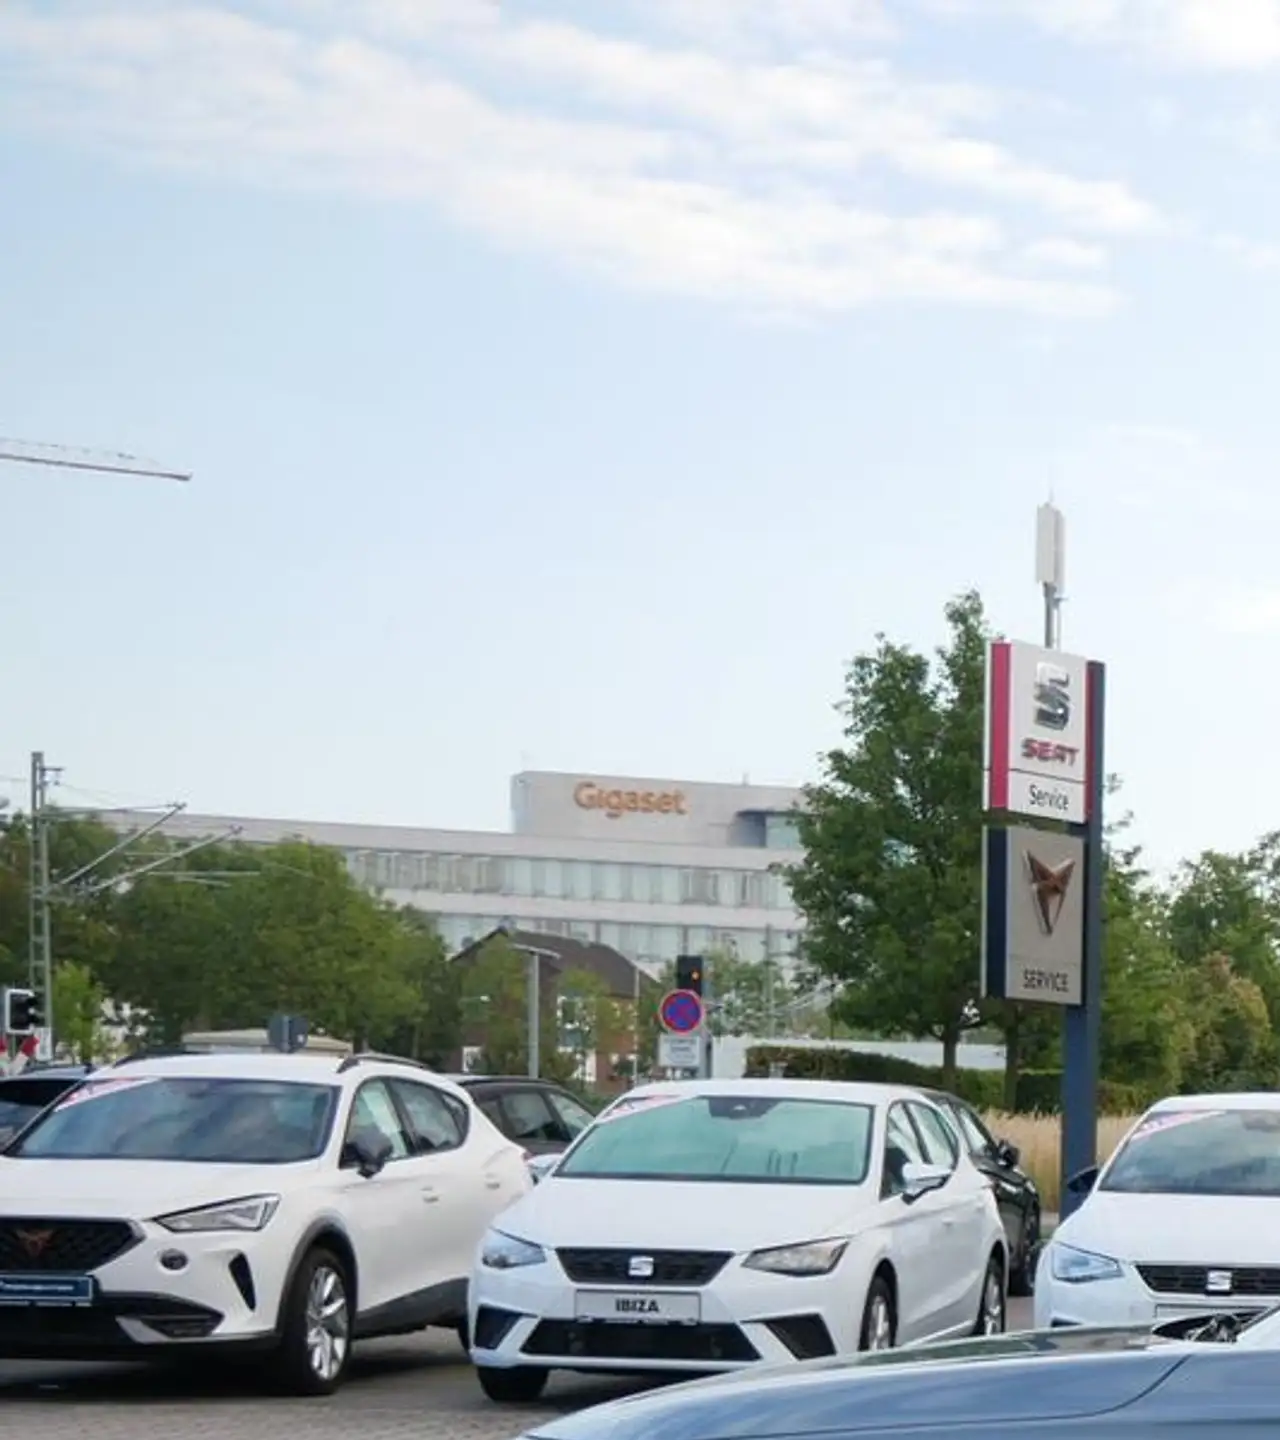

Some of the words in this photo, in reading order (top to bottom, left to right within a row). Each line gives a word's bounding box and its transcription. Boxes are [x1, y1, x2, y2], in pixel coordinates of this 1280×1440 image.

[1021, 737, 1079, 767] SEAT
[573, 781, 688, 820] Gigaset
[1029, 784, 1069, 811] Service
[1023, 967, 1069, 993] SERVICE
[615, 1299, 660, 1313] IBIZA
